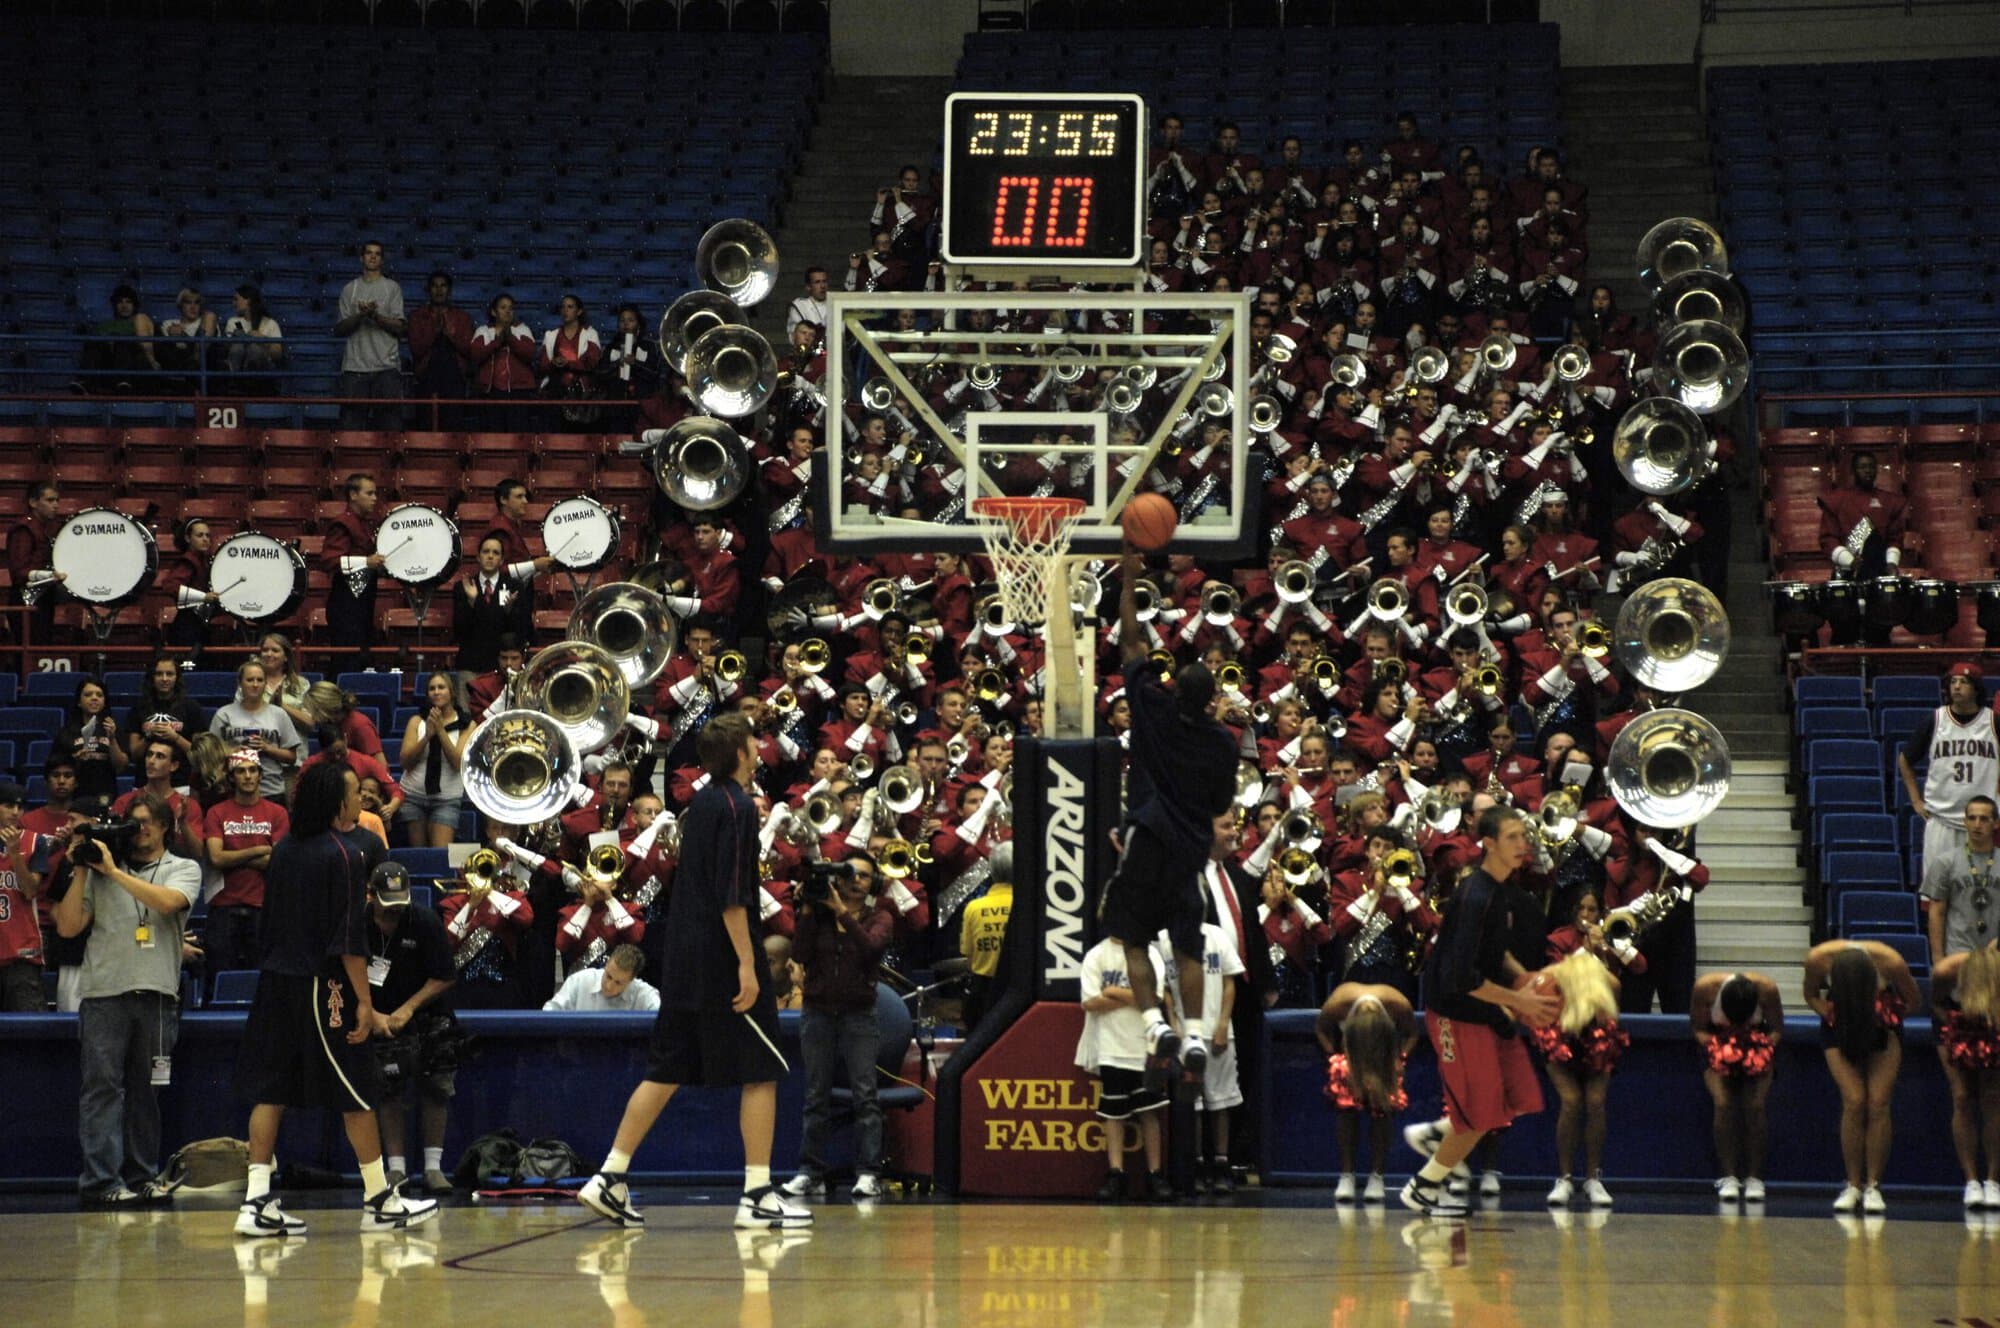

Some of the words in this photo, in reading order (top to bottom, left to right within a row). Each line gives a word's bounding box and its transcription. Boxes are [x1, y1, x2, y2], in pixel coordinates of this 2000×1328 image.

[968, 113, 1118, 156] 23:55
[991, 176, 1094, 247] 00
[208, 407, 238, 429] 20
[400, 518, 434, 529] YAMAHA
[562, 509, 595, 523] YAMAHA
[84, 523, 126, 535] YAMAHA
[240, 547, 280, 560] YAMAHA
[37, 657, 72, 673] 20
[1933, 738, 1996, 760] ARIZONA
[1953, 762, 1974, 783] 31
[1045, 755, 1085, 980] ARIZONA
[981, 906, 1009, 917] EVE
[976, 936, 1003, 951] SEC
[327, 978, 345, 1028] CATS
